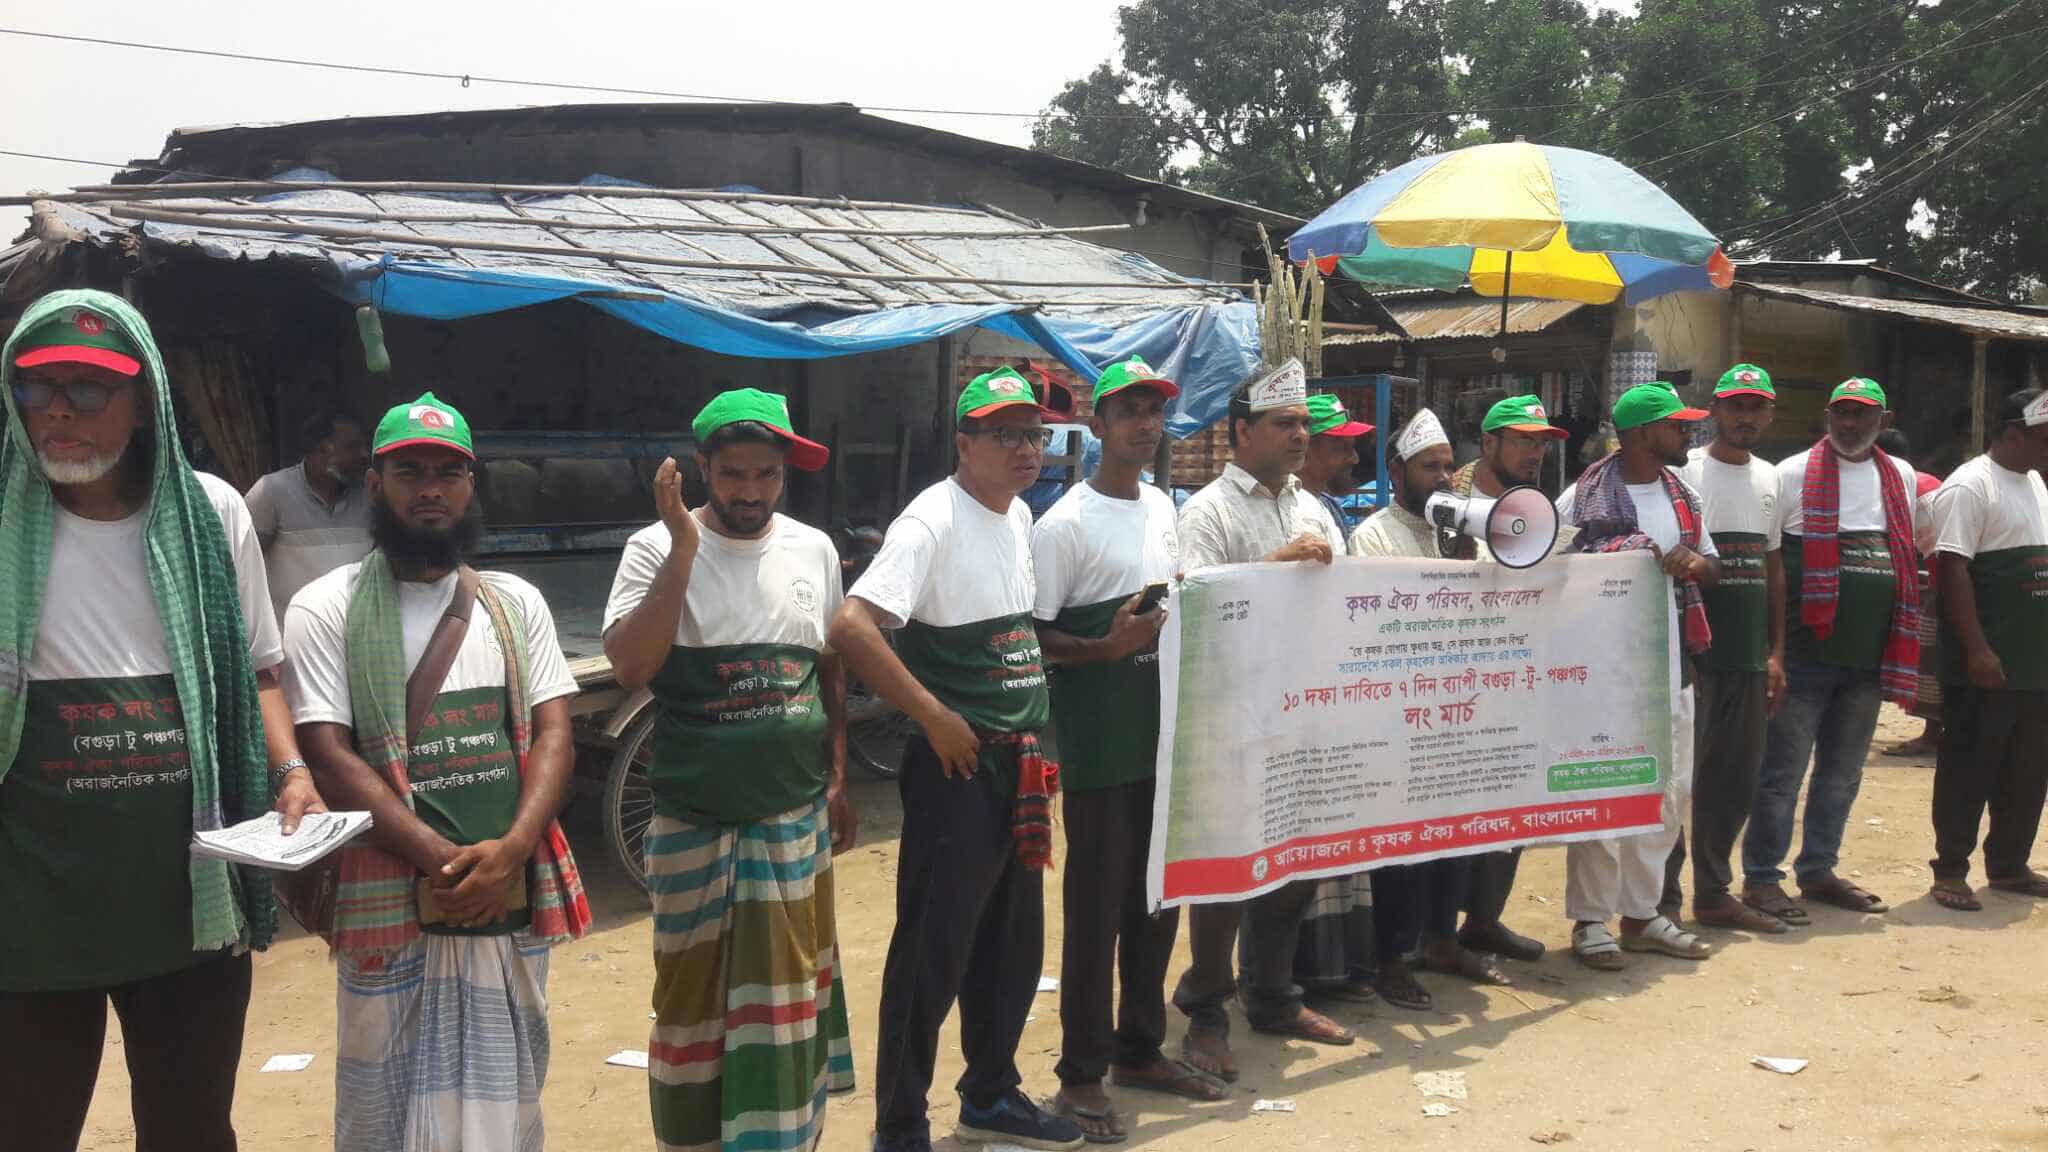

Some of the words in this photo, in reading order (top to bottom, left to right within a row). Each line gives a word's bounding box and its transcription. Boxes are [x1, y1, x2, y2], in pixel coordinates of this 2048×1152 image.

[1345, 593, 1382, 622] কৃষক
[1387, 587, 1420, 611] ঐক্য
[1426, 586, 1473, 612] পরিষদ,
[1481, 588, 1544, 608] বাংলাদেশ
[1404, 616, 1454, 633] অরাজনৈতিক
[1282, 692, 1299, 712] ১০
[1304, 686, 1337, 707] দফা
[1344, 680, 1393, 704] দাবিতে
[1400, 681, 1408, 698] ৭
[1413, 673, 1437, 697] দিন
[1443, 668, 1477, 693] ব্যাপী
[1482, 669, 1515, 690] বগুড়া
[1547, 665, 1588, 686] পঞ্চগড়
[58, 704, 117, 732] কৃষক
[124, 700, 157, 720] লং
[1404, 706, 1432, 730] লং
[1439, 693, 1481, 725] মার্চ
[73, 732, 121, 752] (বগুড়া
[125, 730, 137, 750] টু
[409, 740, 443, 756] বগুড়া
[66, 771, 154, 793] (অরাজনৈতিক
[1274, 839, 1352, 867] আয়োজনে
[1371, 832, 1412, 855] কৃষক
[1419, 826, 1454, 842] ঐক্য
[1461, 820, 1516, 839] পরিষদ,
[1522, 808, 1598, 829] বাংলাদেশ
